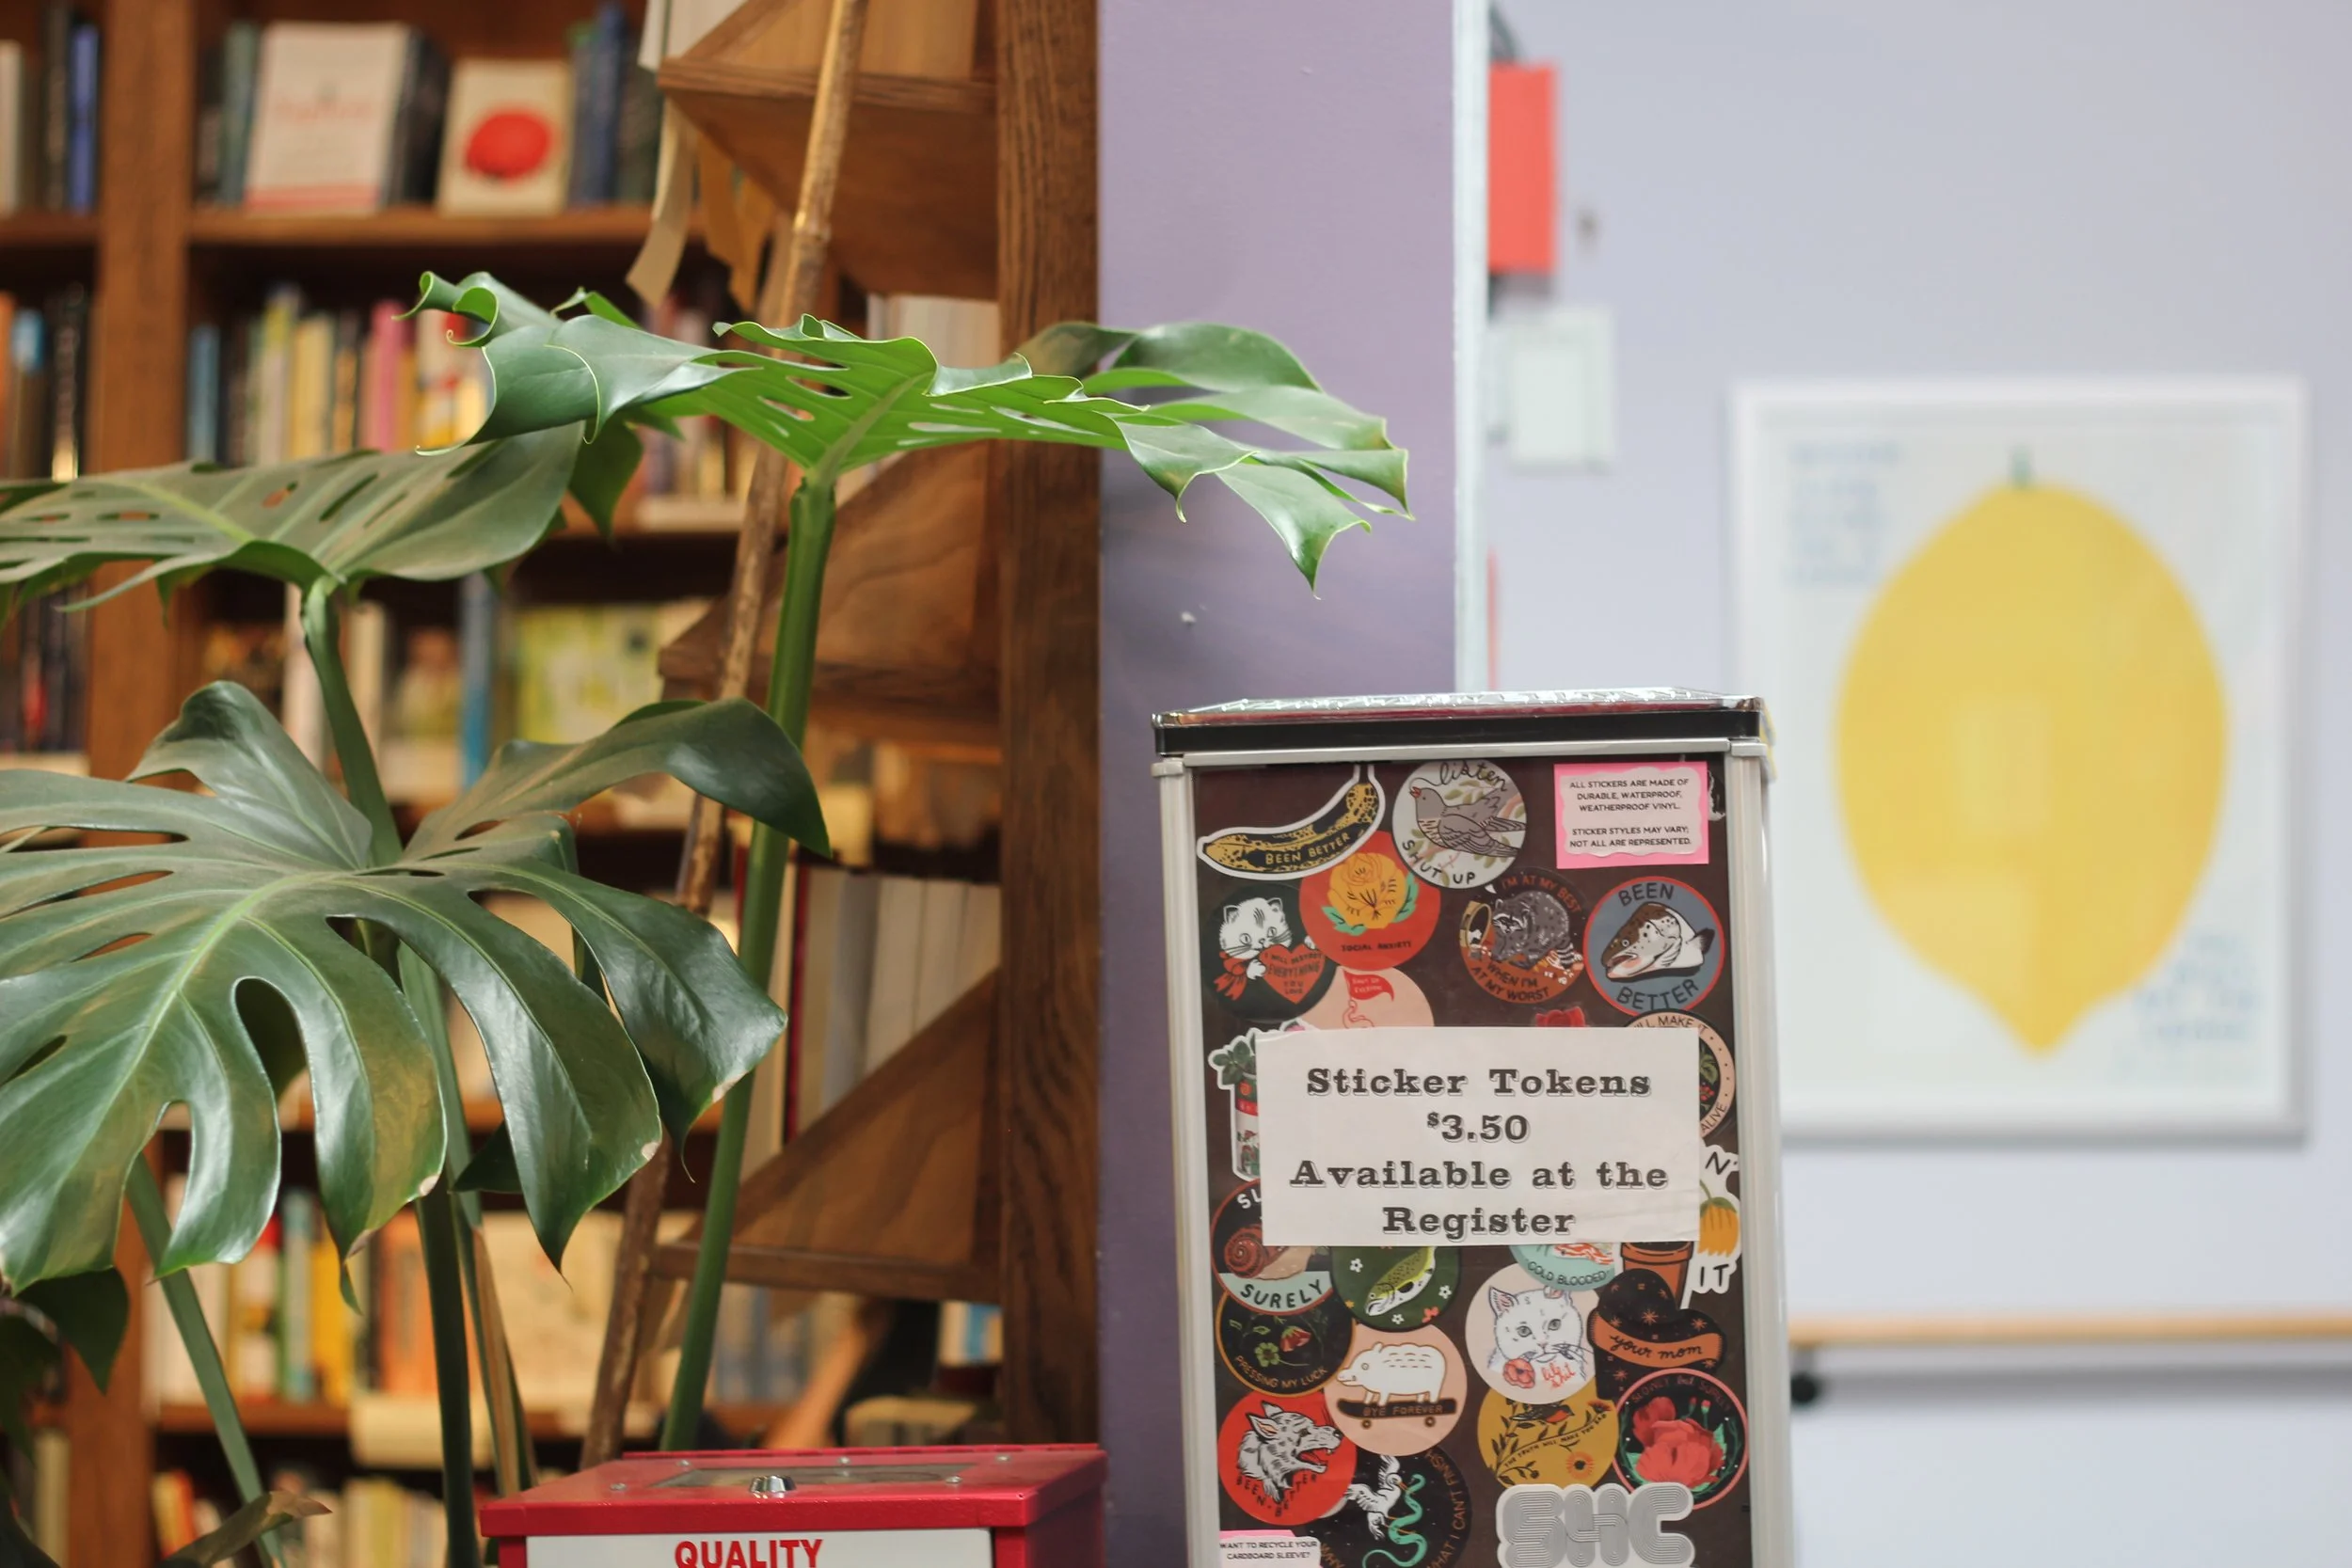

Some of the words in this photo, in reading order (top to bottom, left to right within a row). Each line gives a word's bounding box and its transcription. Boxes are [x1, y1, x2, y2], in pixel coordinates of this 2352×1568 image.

[1439, 759, 1507, 791] listen
[1588, 780, 1628, 788] STICKERS
[1577, 792, 1619, 800] DURABLE,
[1579, 803, 1649, 812] WEATHERPROOF
[1265, 853, 1301, 864] BEEN
[1308, 832, 1350, 858] BETTER
[1629, 837, 1691, 846] REPRESENTED.
[1402, 839, 1442, 879] SHUT
[1453, 872, 1475, 884] UP
[1523, 875, 1536, 884] AT
[1557, 887, 1581, 912] BEST
[1618, 882, 1674, 907] BEEN
[1342, 943, 1372, 952] SOCIAL
[1377, 942, 1412, 950] ANXIETY
[1471, 967, 1487, 979] AT
[1485, 980, 1504, 995] MY
[1507, 987, 1549, 1001] WORST
[1487, 963, 1518, 986] WHEN
[1616, 978, 1699, 1011] BETTER
[1658, 1016, 1694, 1027] MAKE
[1307, 1068, 1468, 1096] Sticker
[1488, 1068, 1652, 1097] Tokens
[1426, 1111, 1531, 1144] $3.50
[1700, 1101, 1727, 1133] ALIVE
[1289, 1160, 1512, 1189] Available
[1531, 1162, 1576, 1189] at
[1596, 1161, 1670, 1190] the
[1382, 1207, 1577, 1243] Register
[1527, 1260, 1554, 1280] COLD
[1557, 1270, 1607, 1286] BLOODED
[1700, 1263, 1729, 1287] IT
[1240, 1279, 1322, 1308] SURELY
[1609, 1334, 1653, 1357] your
[1658, 1345, 1703, 1359] mom
[1281, 1379, 1297, 1388] MY
[1300, 1367, 1328, 1386] LUCK
[1393, 1405, 1443, 1415] FOREVER
[1236, 1474, 1266, 1506] BEEN
[675, 1539, 823, 1568] QUALITY
